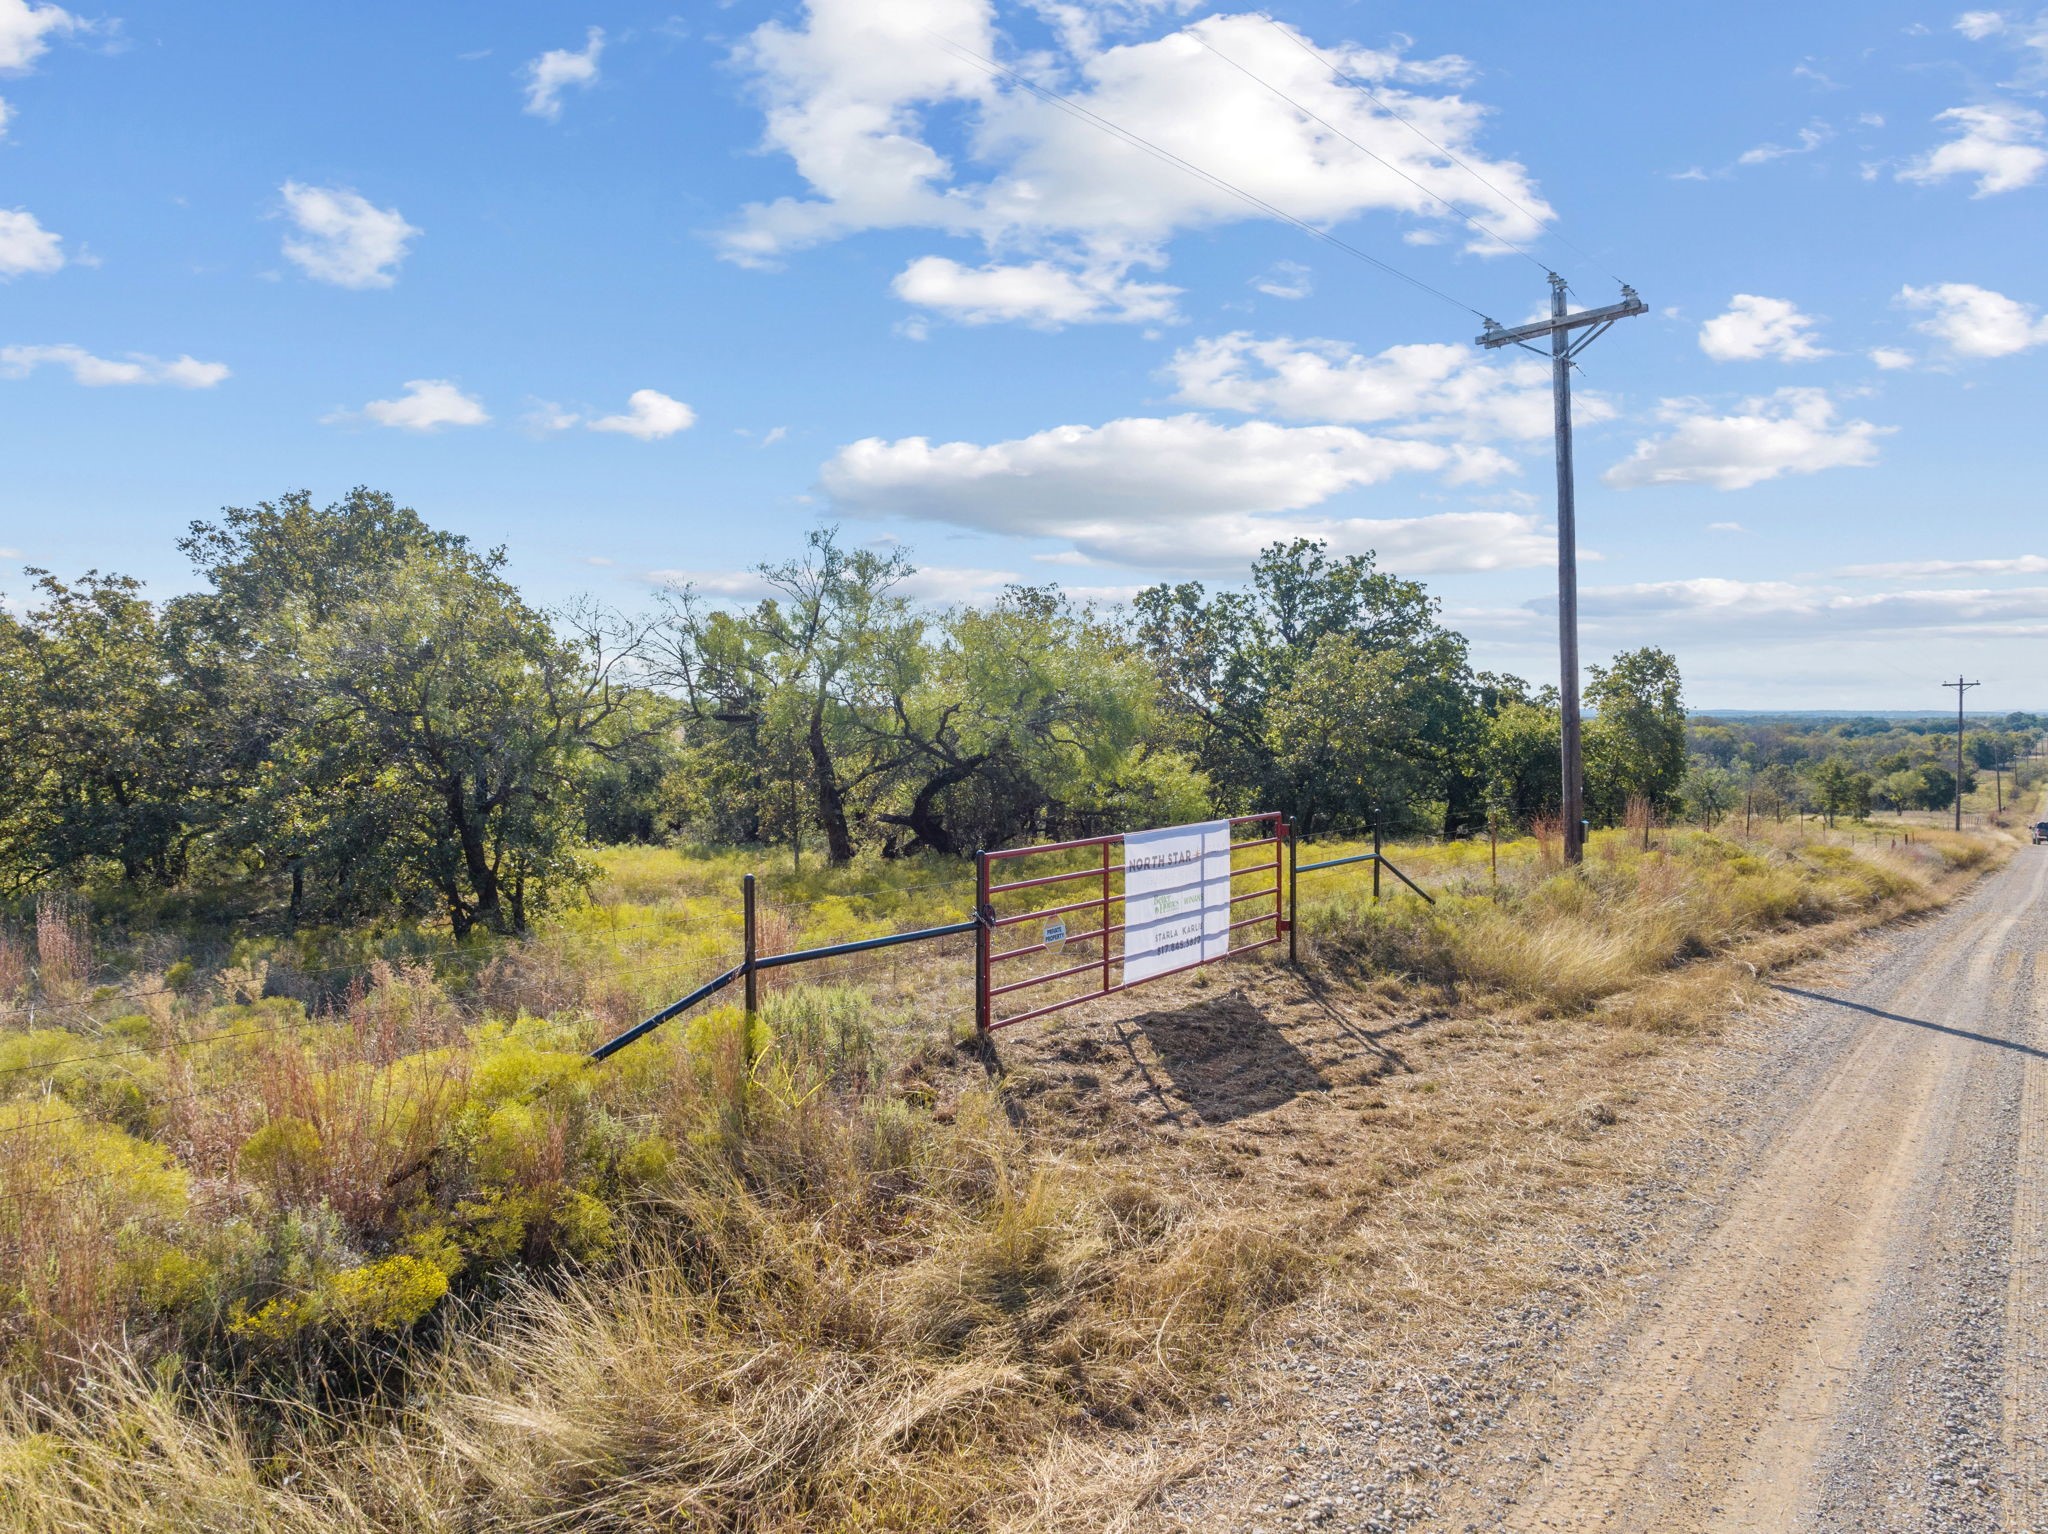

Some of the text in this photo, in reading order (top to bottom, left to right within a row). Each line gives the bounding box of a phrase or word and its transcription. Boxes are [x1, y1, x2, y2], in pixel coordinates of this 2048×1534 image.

[1129, 850, 1192, 872] NORTH STAR
[1046, 926, 1062, 935] PRIVATE
[1155, 929, 1178, 943] STARLA
[1045, 932, 1065, 942] PROPERTY
